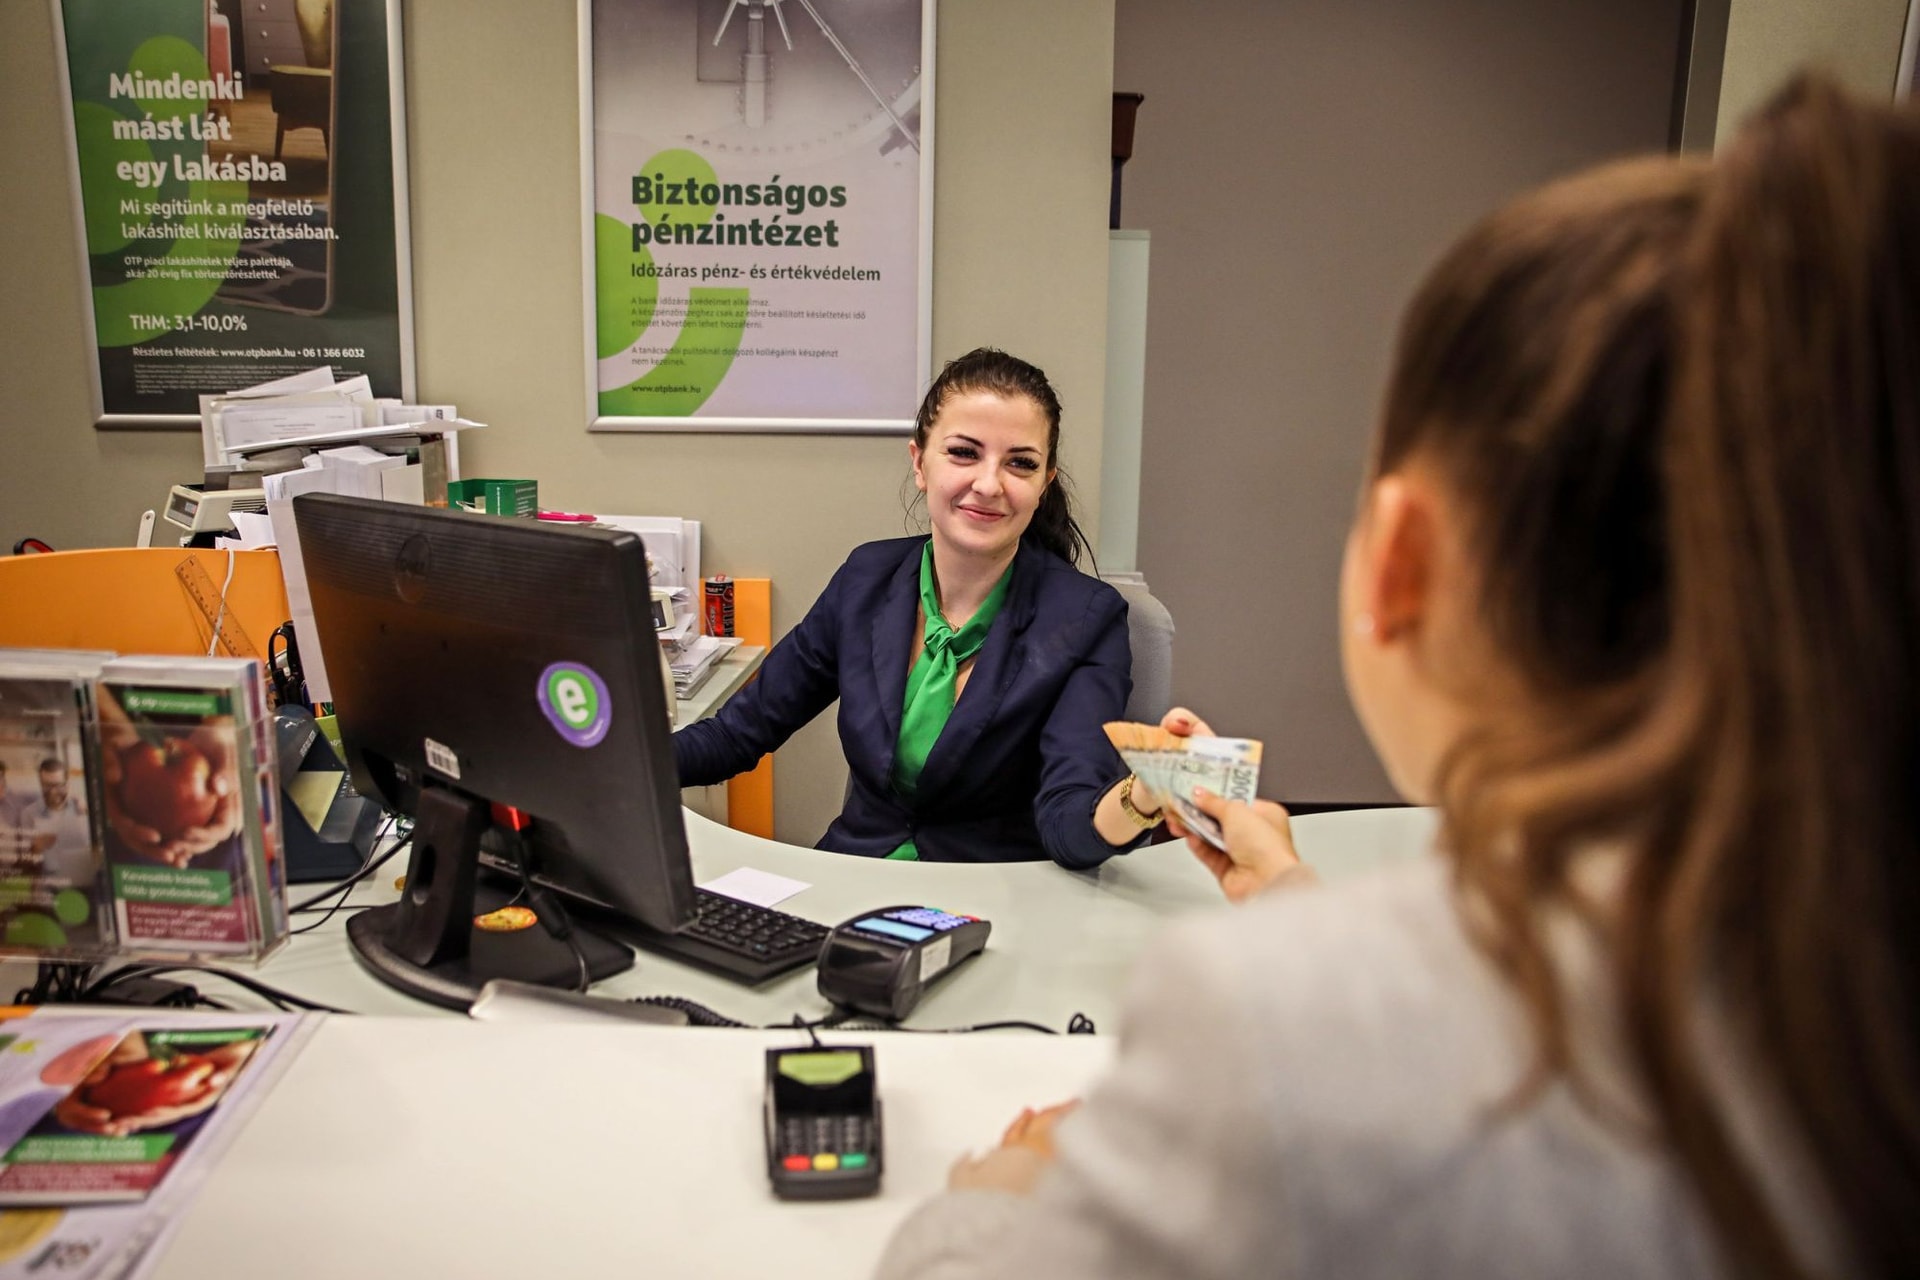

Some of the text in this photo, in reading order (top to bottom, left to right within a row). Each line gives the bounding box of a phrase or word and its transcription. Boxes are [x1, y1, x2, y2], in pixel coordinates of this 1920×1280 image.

[109, 69, 244, 100] Mindenki
[112, 112, 232, 141] mást lát
[116, 153, 287, 188] egy lakásba
[631, 173, 847, 215] Biztonságos
[120, 198, 314, 220] Mi segítünk a megfelelő
[121, 221, 340, 240] lakáshitel kiválasztásában.
[631, 213, 839, 252] pénzintézet
[124, 256, 294, 268] OTP piaci lakáshitelek teljes palettája,
[125, 269, 281, 281] akár 20 évig fix törlesztőrészlettel.
[631, 262, 881, 282] Időzáras pénz- és értékvédelem
[631, 297, 638, 305] A
[129, 314, 171, 331] THM:
[631, 308, 638, 316] A
[853, 310, 866, 319] idő
[132, 346, 174, 358] Részletes
[175, 346, 219, 358] feltételek:
[220, 347, 296, 360] www.otpbank.hu
[303, 348, 316, 358] 06
[323, 348, 341, 358] 366
[342, 348, 366, 359] 6032
[631, 346, 638, 354] A
[631, 384, 702, 394] www.otpbank.hu
